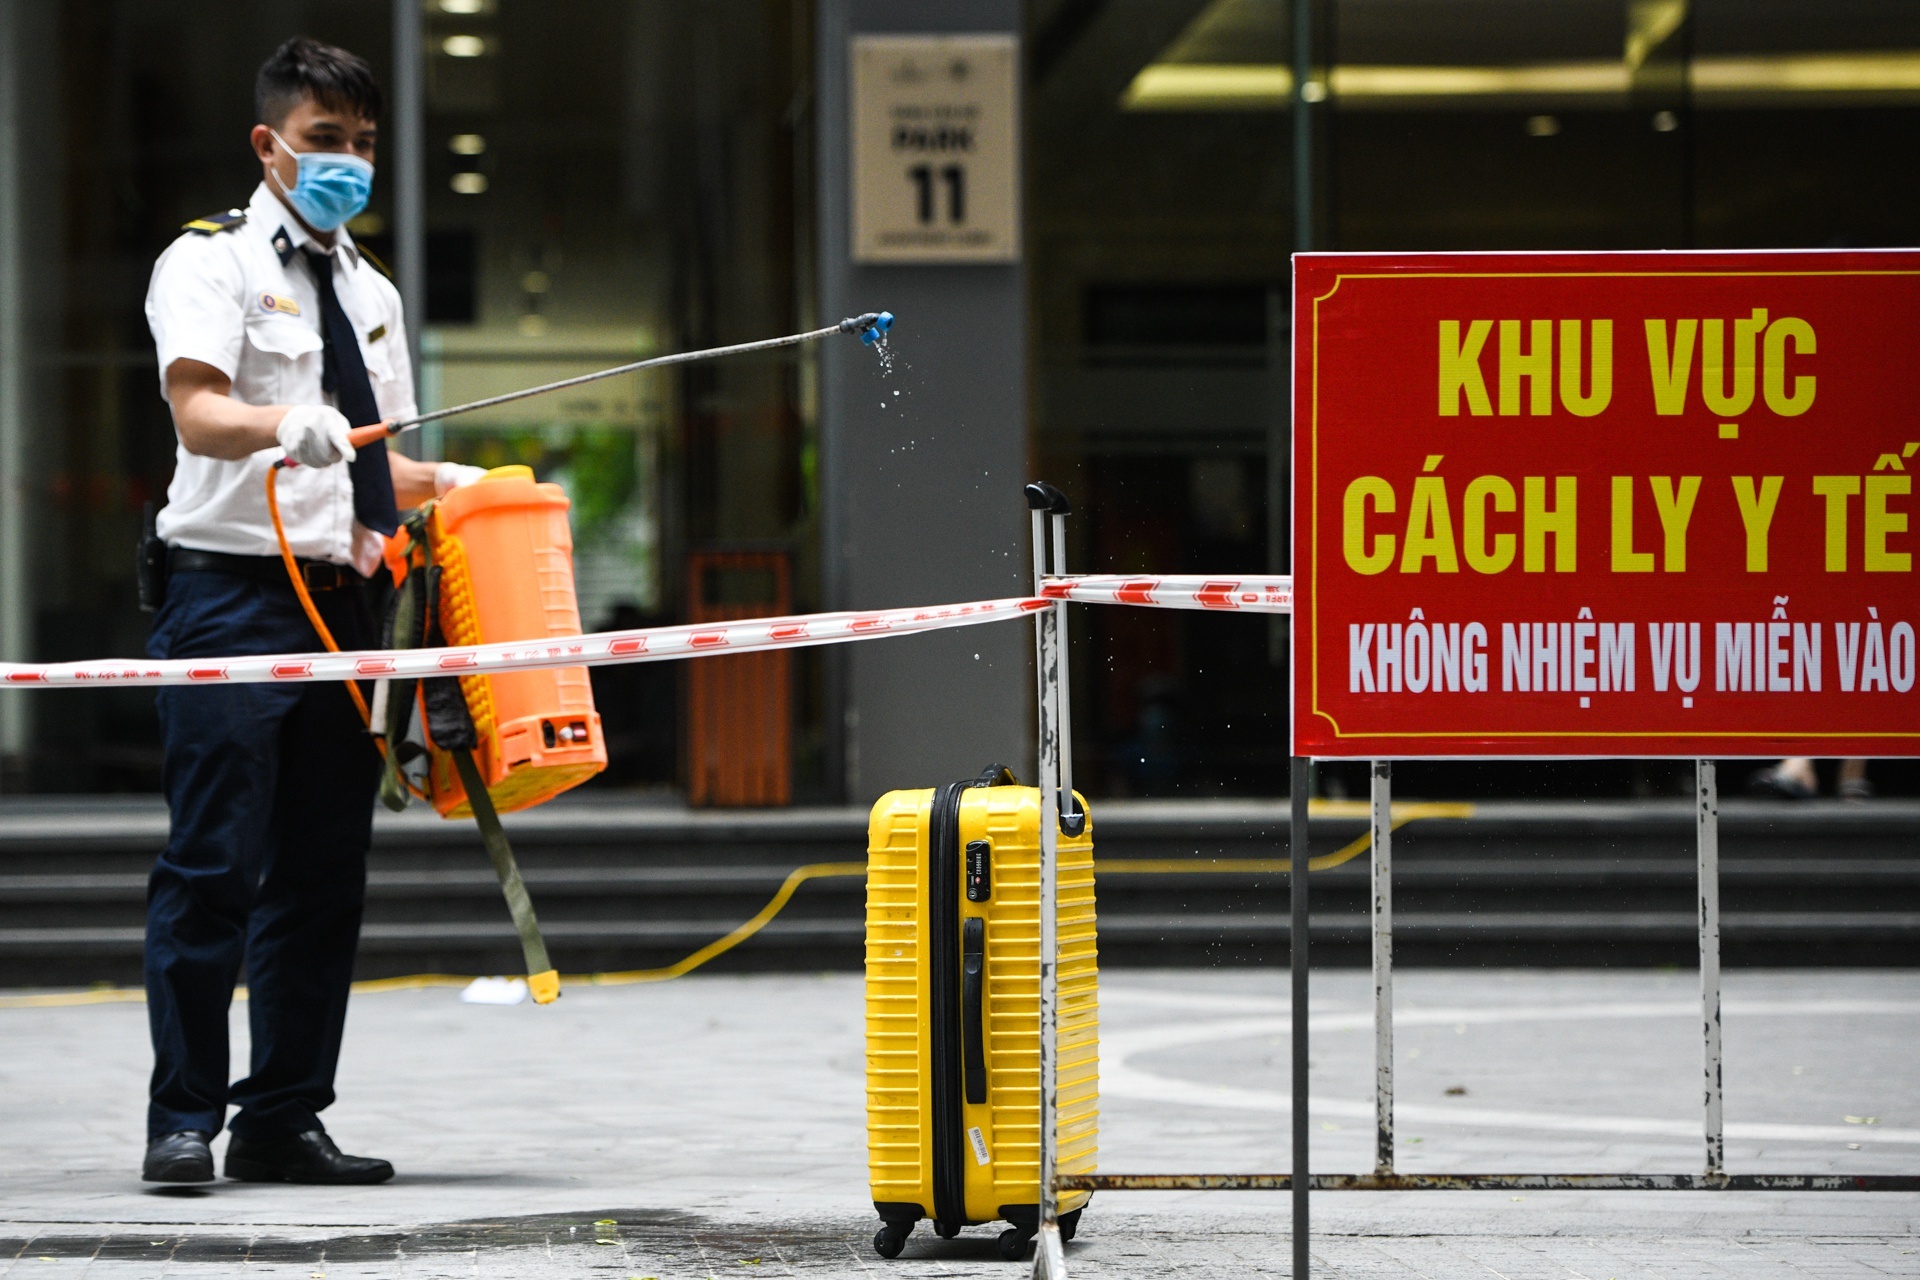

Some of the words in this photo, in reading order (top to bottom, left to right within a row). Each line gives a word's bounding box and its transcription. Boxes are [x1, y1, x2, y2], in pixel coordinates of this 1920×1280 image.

[905, 164, 965, 224] 11
[1438, 319, 1613, 416] KHU
[1645, 308, 1817, 439] VỰC
[1342, 455, 1577, 575] CÁCH
[1611, 476, 1702, 572] LY
[1731, 476, 1785, 572] Y
[1813, 442, 1920, 572] TẾ
[1349, 607, 1488, 693] KHÔNG
[1501, 606, 1636, 708] NHIỆM
[1648, 622, 1701, 708] VỤ
[1715, 595, 1822, 692] MIỄN
[1835, 606, 1916, 693] VÀO
